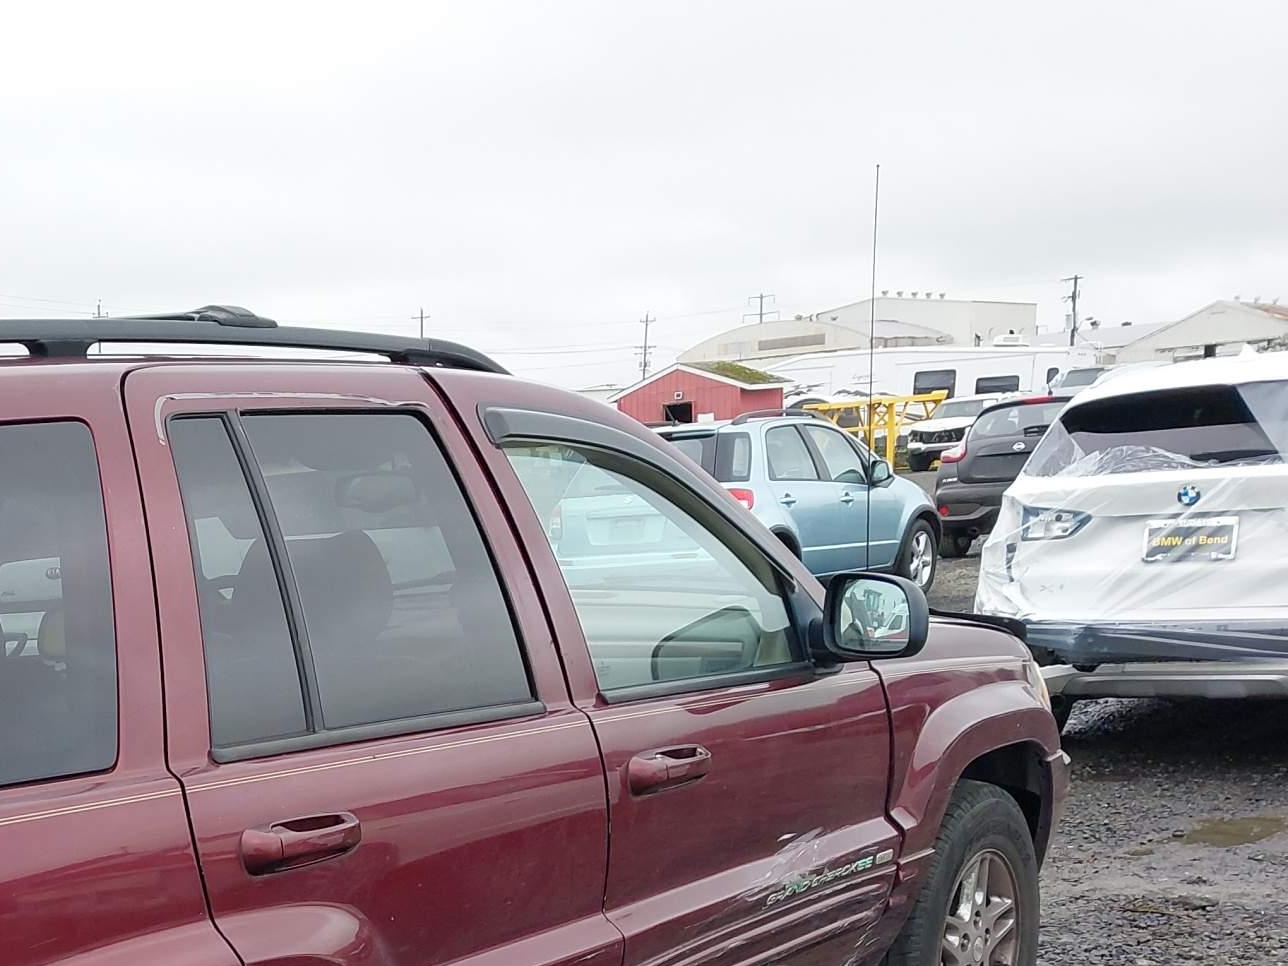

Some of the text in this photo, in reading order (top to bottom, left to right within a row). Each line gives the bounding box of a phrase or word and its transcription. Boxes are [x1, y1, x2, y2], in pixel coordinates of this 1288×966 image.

[1152, 535, 1229, 547] BMW of Bend
